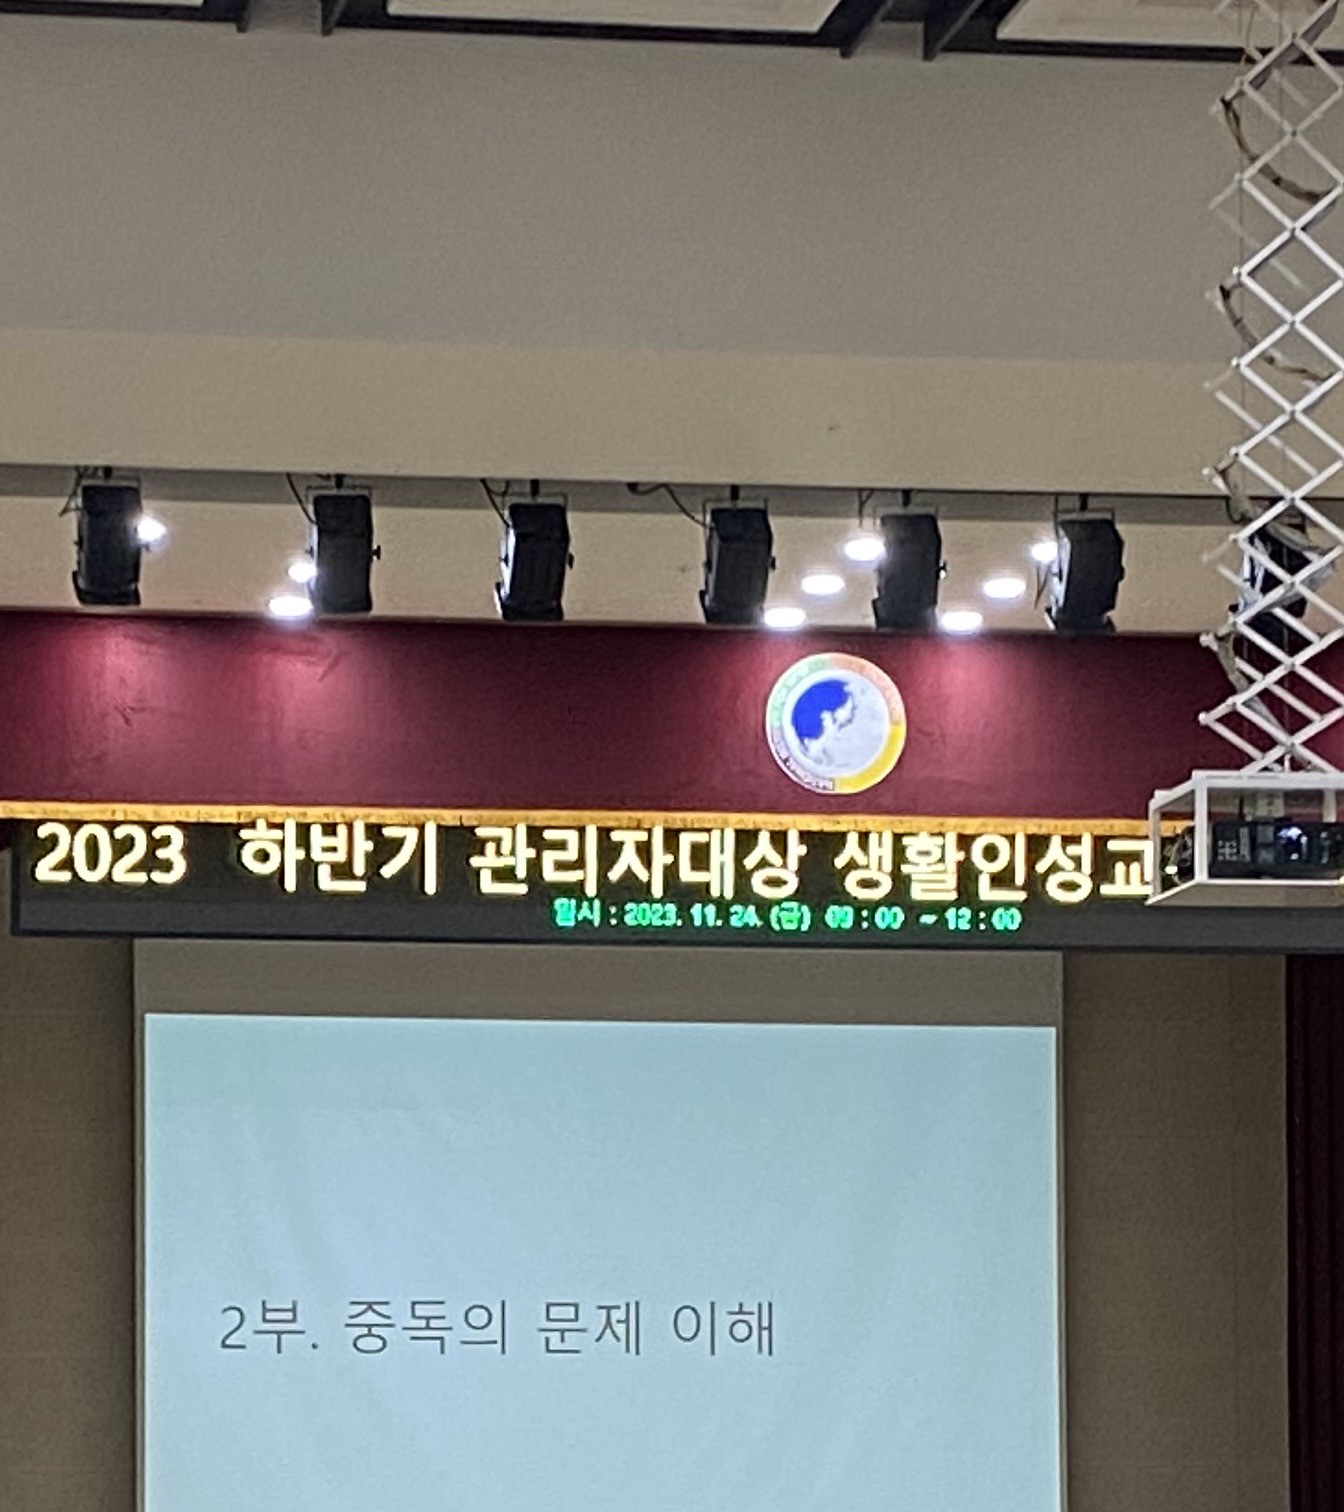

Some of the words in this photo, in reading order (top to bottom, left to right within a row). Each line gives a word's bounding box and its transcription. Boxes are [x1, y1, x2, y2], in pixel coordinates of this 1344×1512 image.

[34, 822, 188, 885] 2023
[238, 820, 440, 897] 하반기
[468, 825, 809, 902] 관리자대상
[218, 1300, 320, 1356] 2부.
[343, 1299, 508, 1356] 중독의
[536, 1300, 642, 1357] 문제
[672, 1301, 776, 1358] 이해
